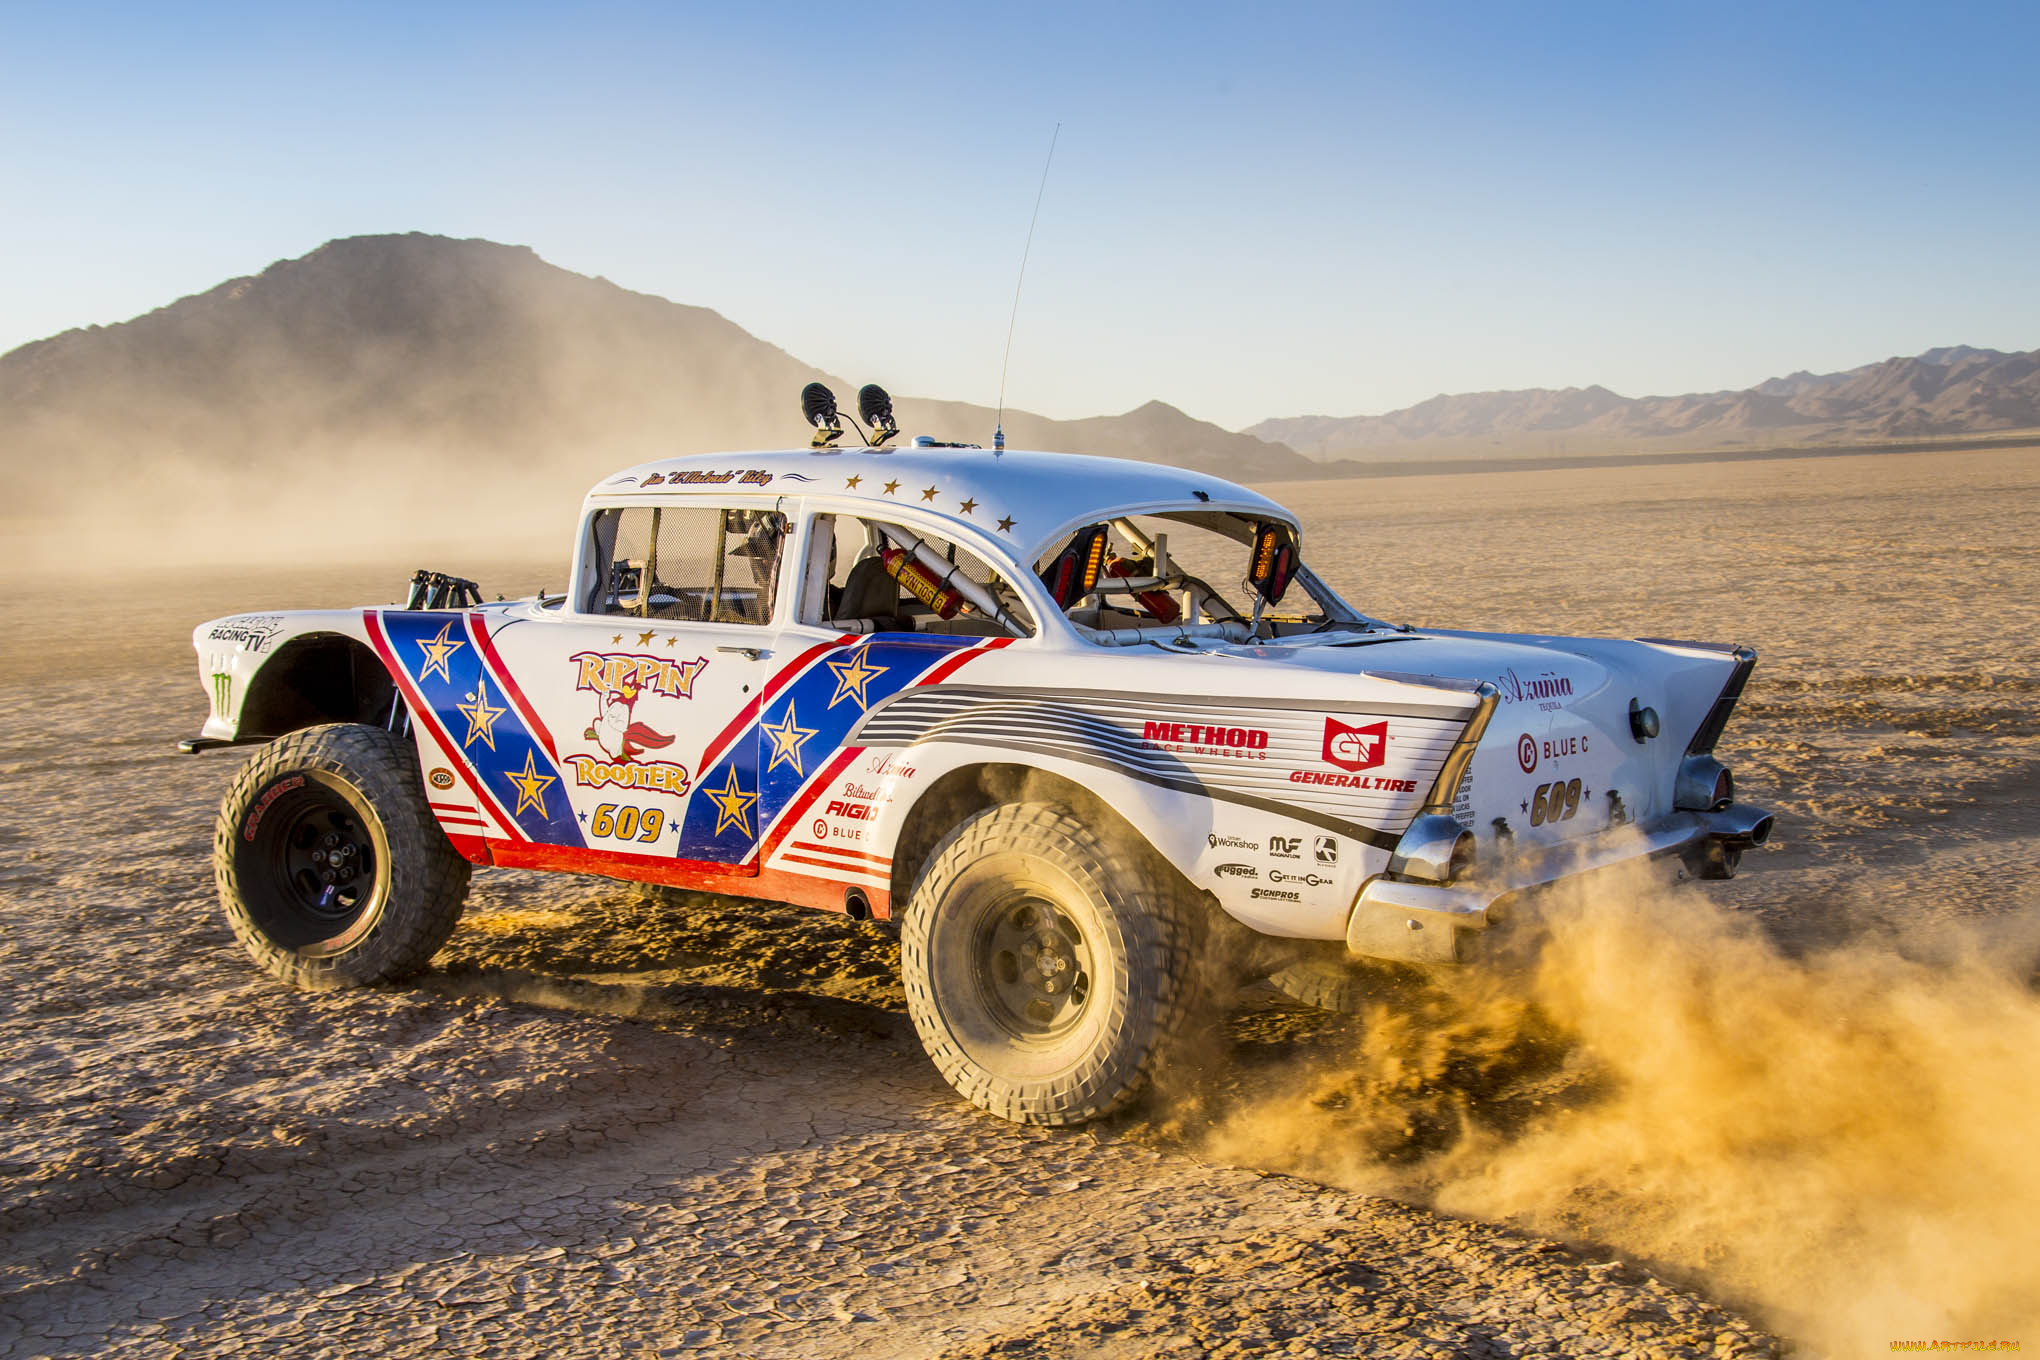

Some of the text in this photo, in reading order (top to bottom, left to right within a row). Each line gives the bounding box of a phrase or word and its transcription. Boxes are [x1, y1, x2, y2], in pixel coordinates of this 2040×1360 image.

[904, 570, 944, 610] GSOLINA
[208, 629, 267, 652] RACING TV
[1143, 721, 1268, 749] METHOD
[1544, 737, 1577, 760] BLUE
[1581, 735, 1589, 753] C
[1141, 741, 1267, 761] RACE WHEELS
[563, 754, 691, 797] ROOSTER
[1374, 778, 1417, 793] TIRE
[1530, 777, 1582, 828] 609
[591, 803, 664, 843] 609
[833, 826, 862, 840] BLUE
[1218, 837, 1259, 852] Workshop
